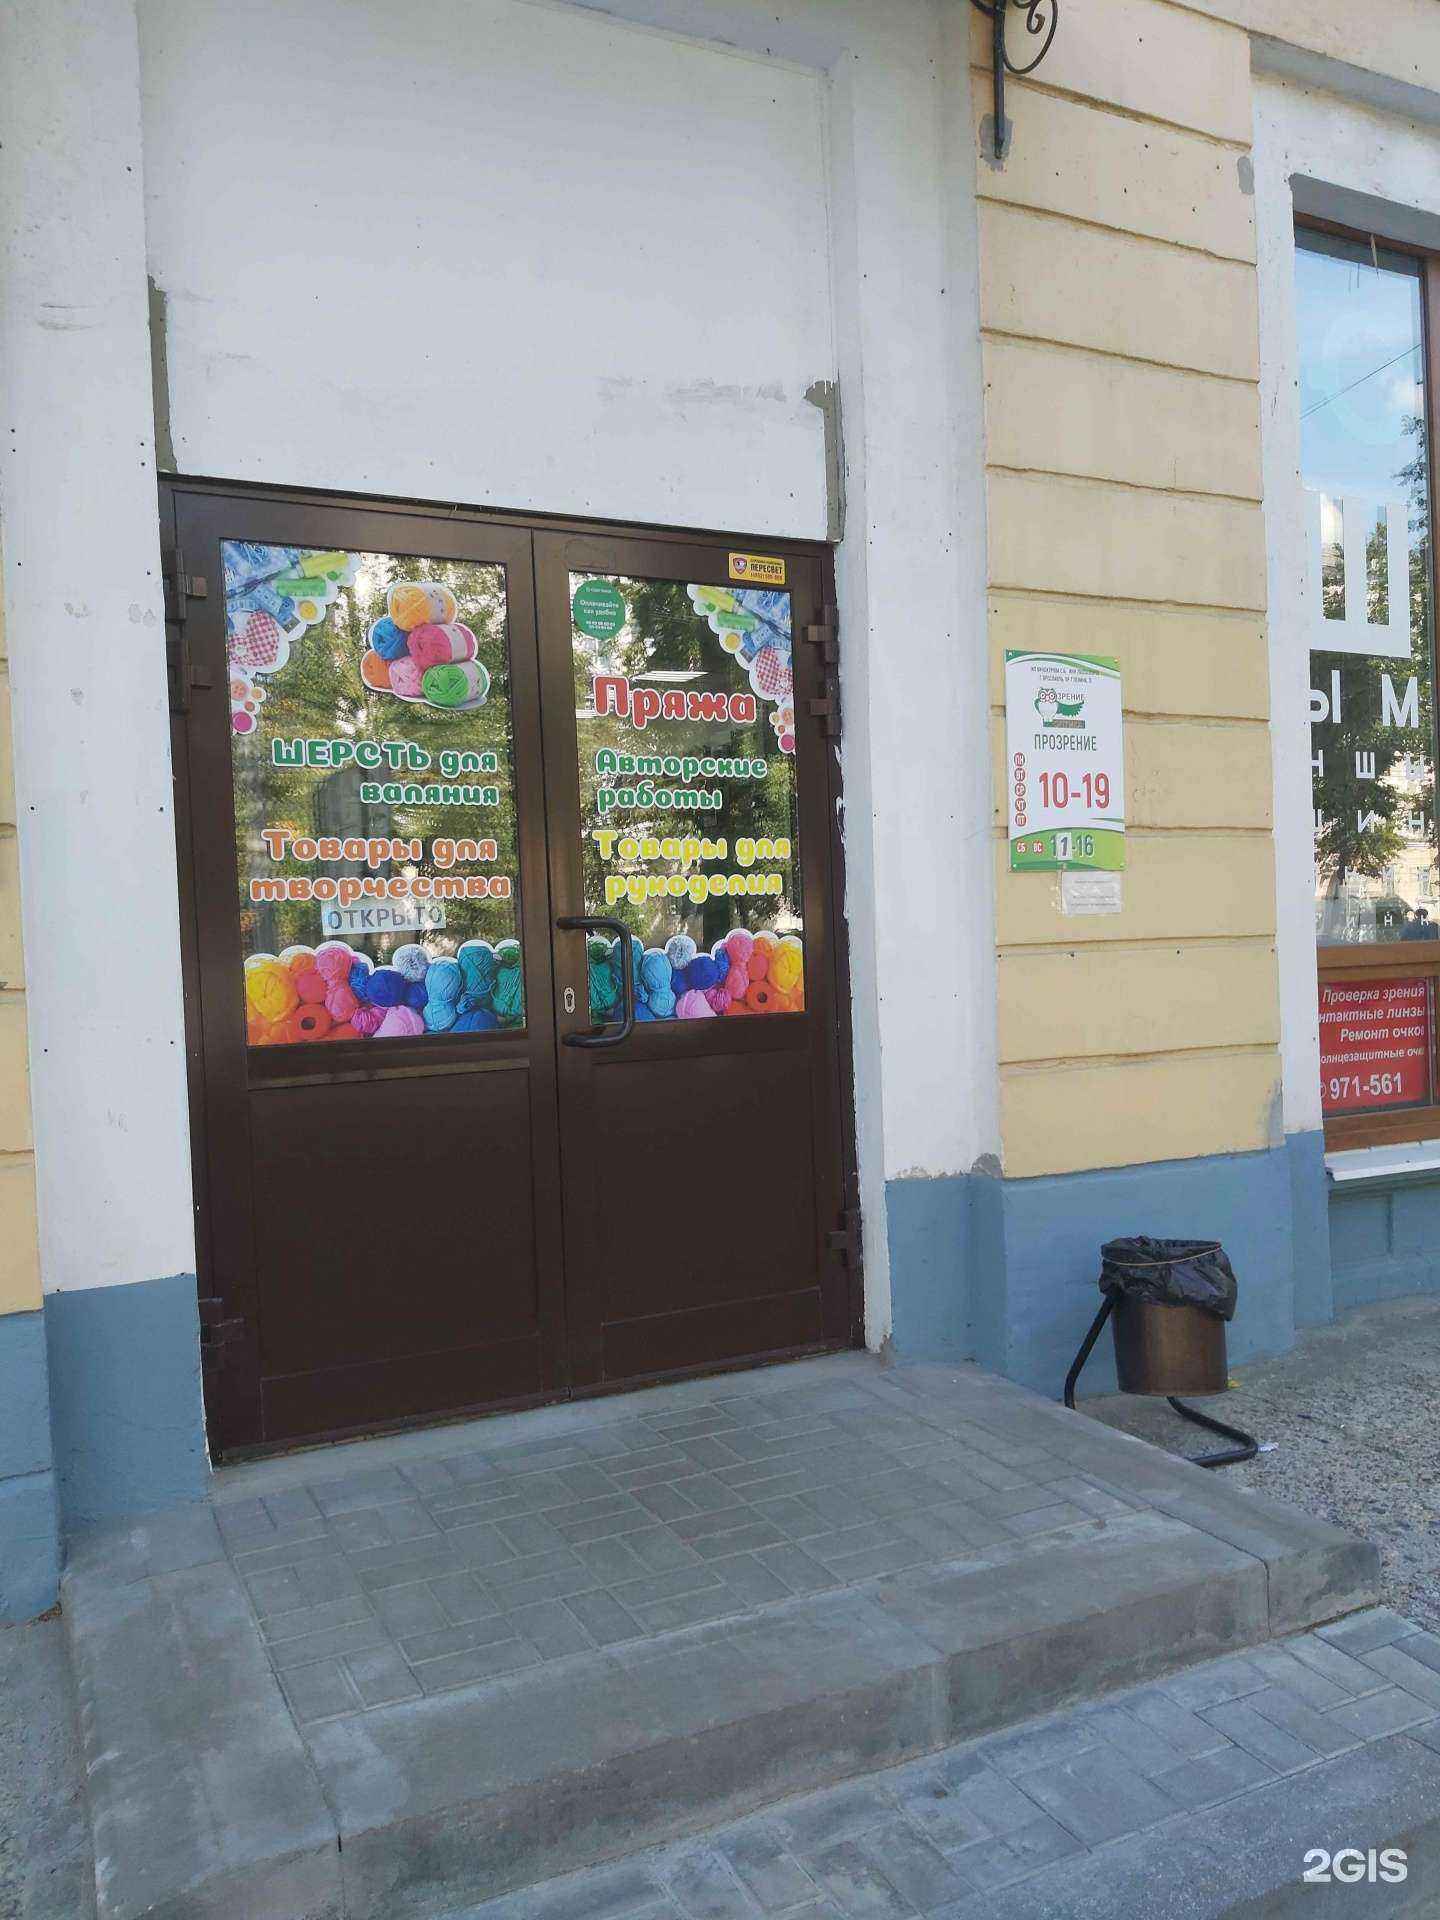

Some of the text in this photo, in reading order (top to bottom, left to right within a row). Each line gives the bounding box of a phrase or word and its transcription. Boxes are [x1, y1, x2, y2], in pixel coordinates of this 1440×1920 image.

[750, 563, 783, 575] ПЕРЕСВЕТ
[593, 676, 757, 730] Пряжа
[1381, 673, 1419, 728] М
[1034, 734, 1097, 751] ПРОЗРЕНИЕ
[272, 738, 498, 778] ШЕРСТЬ для
[596, 747, 768, 783] Авторские
[1355, 751, 1375, 779] Ш
[360, 783, 500, 806] валяния
[597, 780, 723, 814] работы
[1039, 772, 1110, 809] 10-19
[261, 829, 498, 869] Товары для
[592, 830, 792, 867] Товары для
[250, 876, 511, 908] творчества
[604, 873, 783, 905] рукоделия
[328, 906, 442, 930] ОТКРЫТО
[1322, 987, 1425, 1005] Проверка зрения
[1319, 1007, 1425, 1023] нтактные линзы
[1340, 1028, 1389, 1042] Ремонт
[1320, 1046, 1425, 1064] олнцезащитные очк
[1330, 1072, 1402, 1100] 971-561
